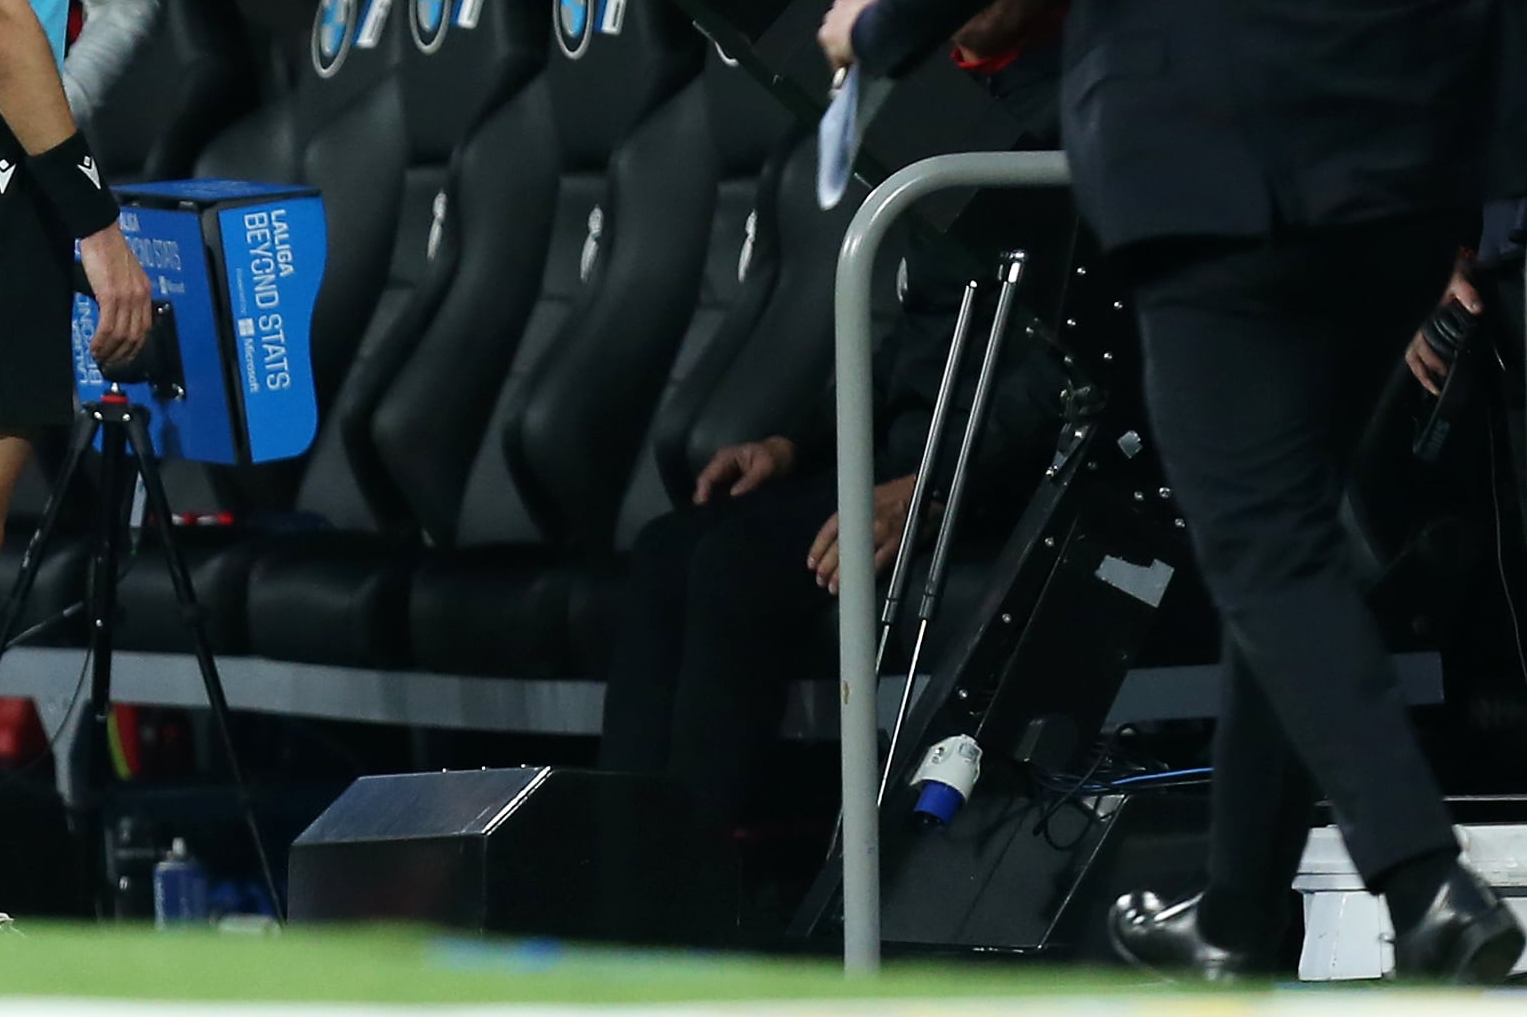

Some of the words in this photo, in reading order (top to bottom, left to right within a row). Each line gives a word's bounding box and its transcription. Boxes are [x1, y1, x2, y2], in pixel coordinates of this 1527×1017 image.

[244, 211, 280, 309] BEYOND
[271, 209, 294, 277] LALIGA
[244, 338, 260, 394] Microsoft
[258, 313, 291, 390] STATS
